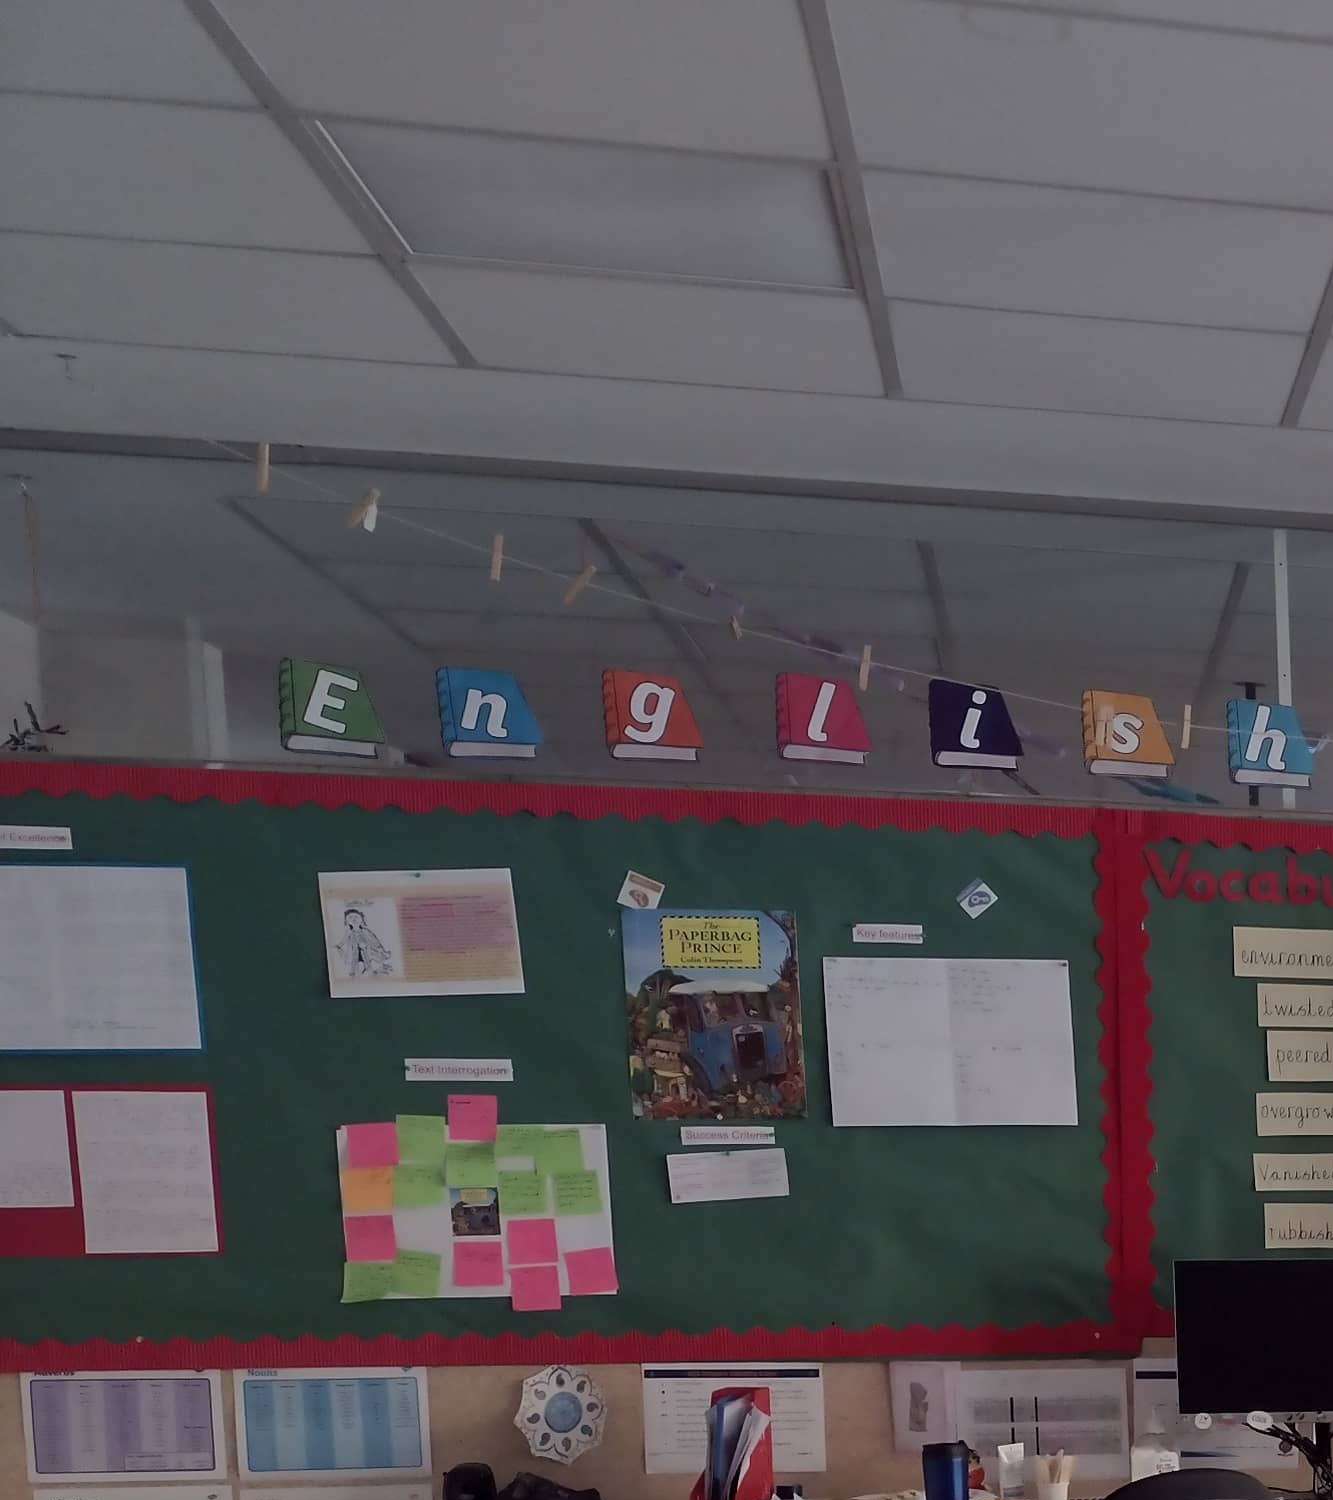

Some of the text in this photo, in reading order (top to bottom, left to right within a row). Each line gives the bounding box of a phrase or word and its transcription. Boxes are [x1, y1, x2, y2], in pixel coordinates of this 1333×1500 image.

[703, 922, 720, 930] The
[669, 930, 752, 942] PAPERBAG
[681, 942, 743, 954] PRINCE
[1276, 1041, 1333, 1075] peered
[411, 1064, 507, 1077] Text Interrogation
[686, 1130, 728, 1140] Success
